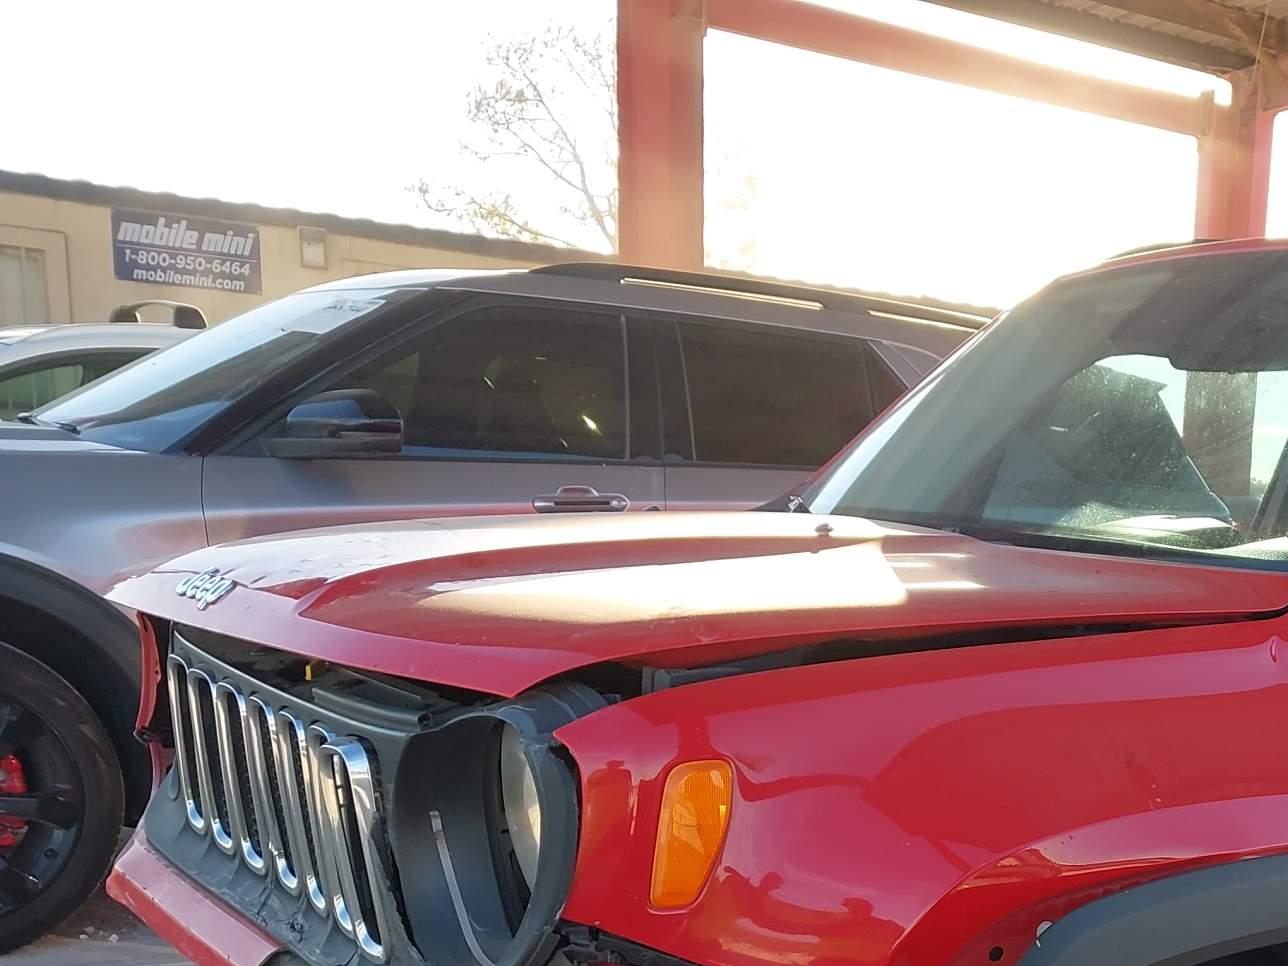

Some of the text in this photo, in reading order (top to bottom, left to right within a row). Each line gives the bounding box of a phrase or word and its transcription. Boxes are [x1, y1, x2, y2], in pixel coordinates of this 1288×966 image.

[117, 217, 255, 256] mobile mini
[124, 249, 250, 276] 1-800-950-6464
[133, 268, 245, 291] mobilemini.com
[176, 567, 237, 610] Jeep
